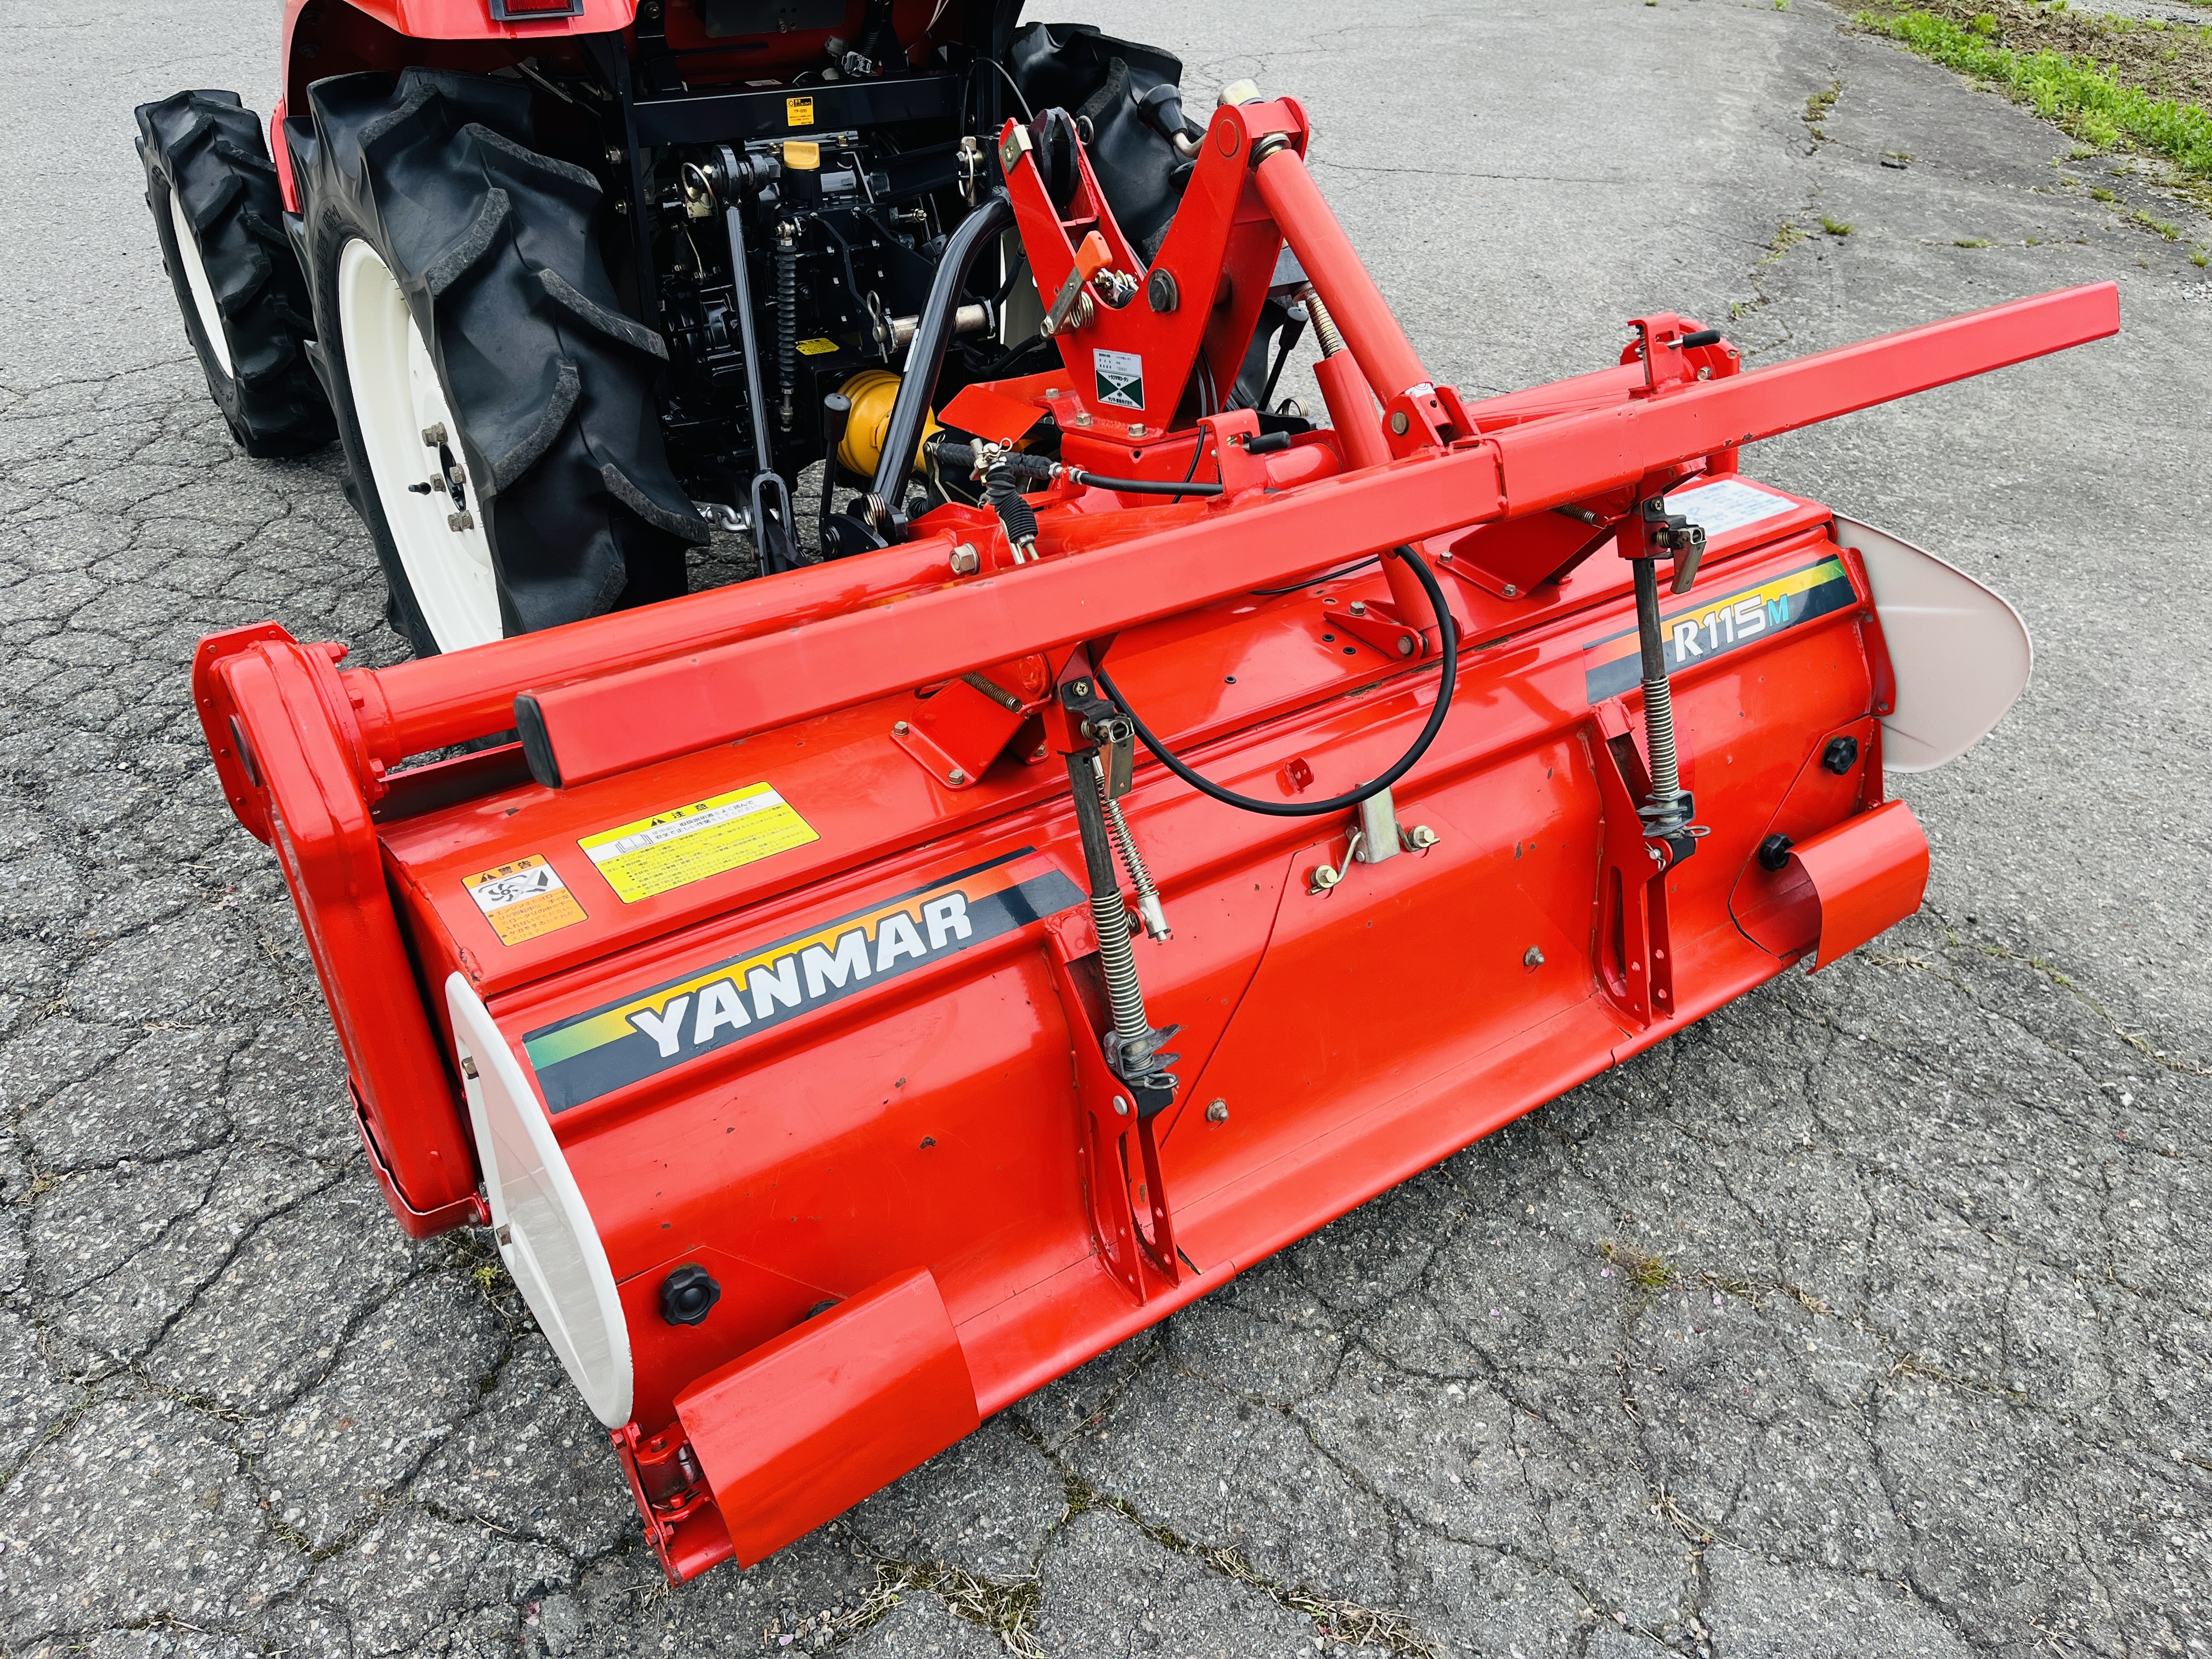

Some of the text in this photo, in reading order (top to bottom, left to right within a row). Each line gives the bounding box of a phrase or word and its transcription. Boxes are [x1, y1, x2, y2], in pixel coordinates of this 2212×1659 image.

[669, 803, 709, 819] 注意
[495, 888, 566, 916] エンジンまたはロータ
[630, 892, 973, 1059] YANMAR
